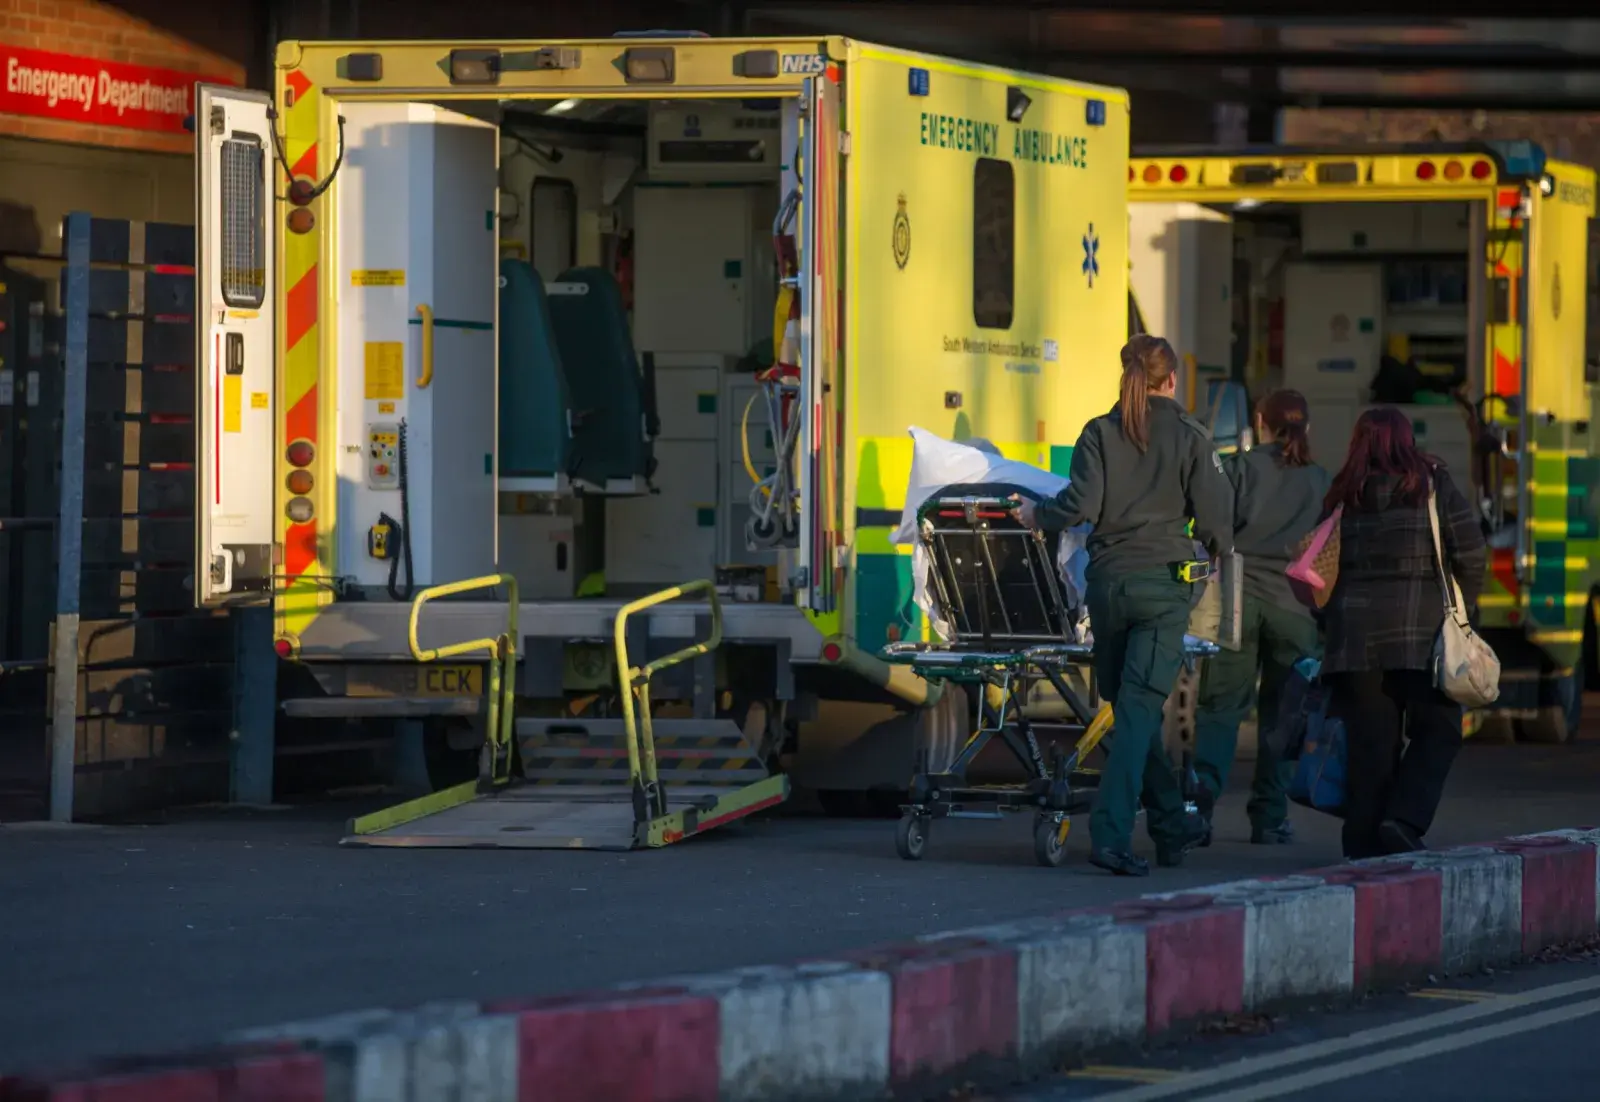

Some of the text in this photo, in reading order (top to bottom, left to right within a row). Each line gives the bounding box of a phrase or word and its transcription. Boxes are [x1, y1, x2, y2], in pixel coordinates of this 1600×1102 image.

[783, 55, 825, 72] NHS
[7, 57, 189, 116] Emergency Department
[921, 112, 1087, 169] EMERGENCY AMBULANCE
[426, 669, 471, 692] CCK
